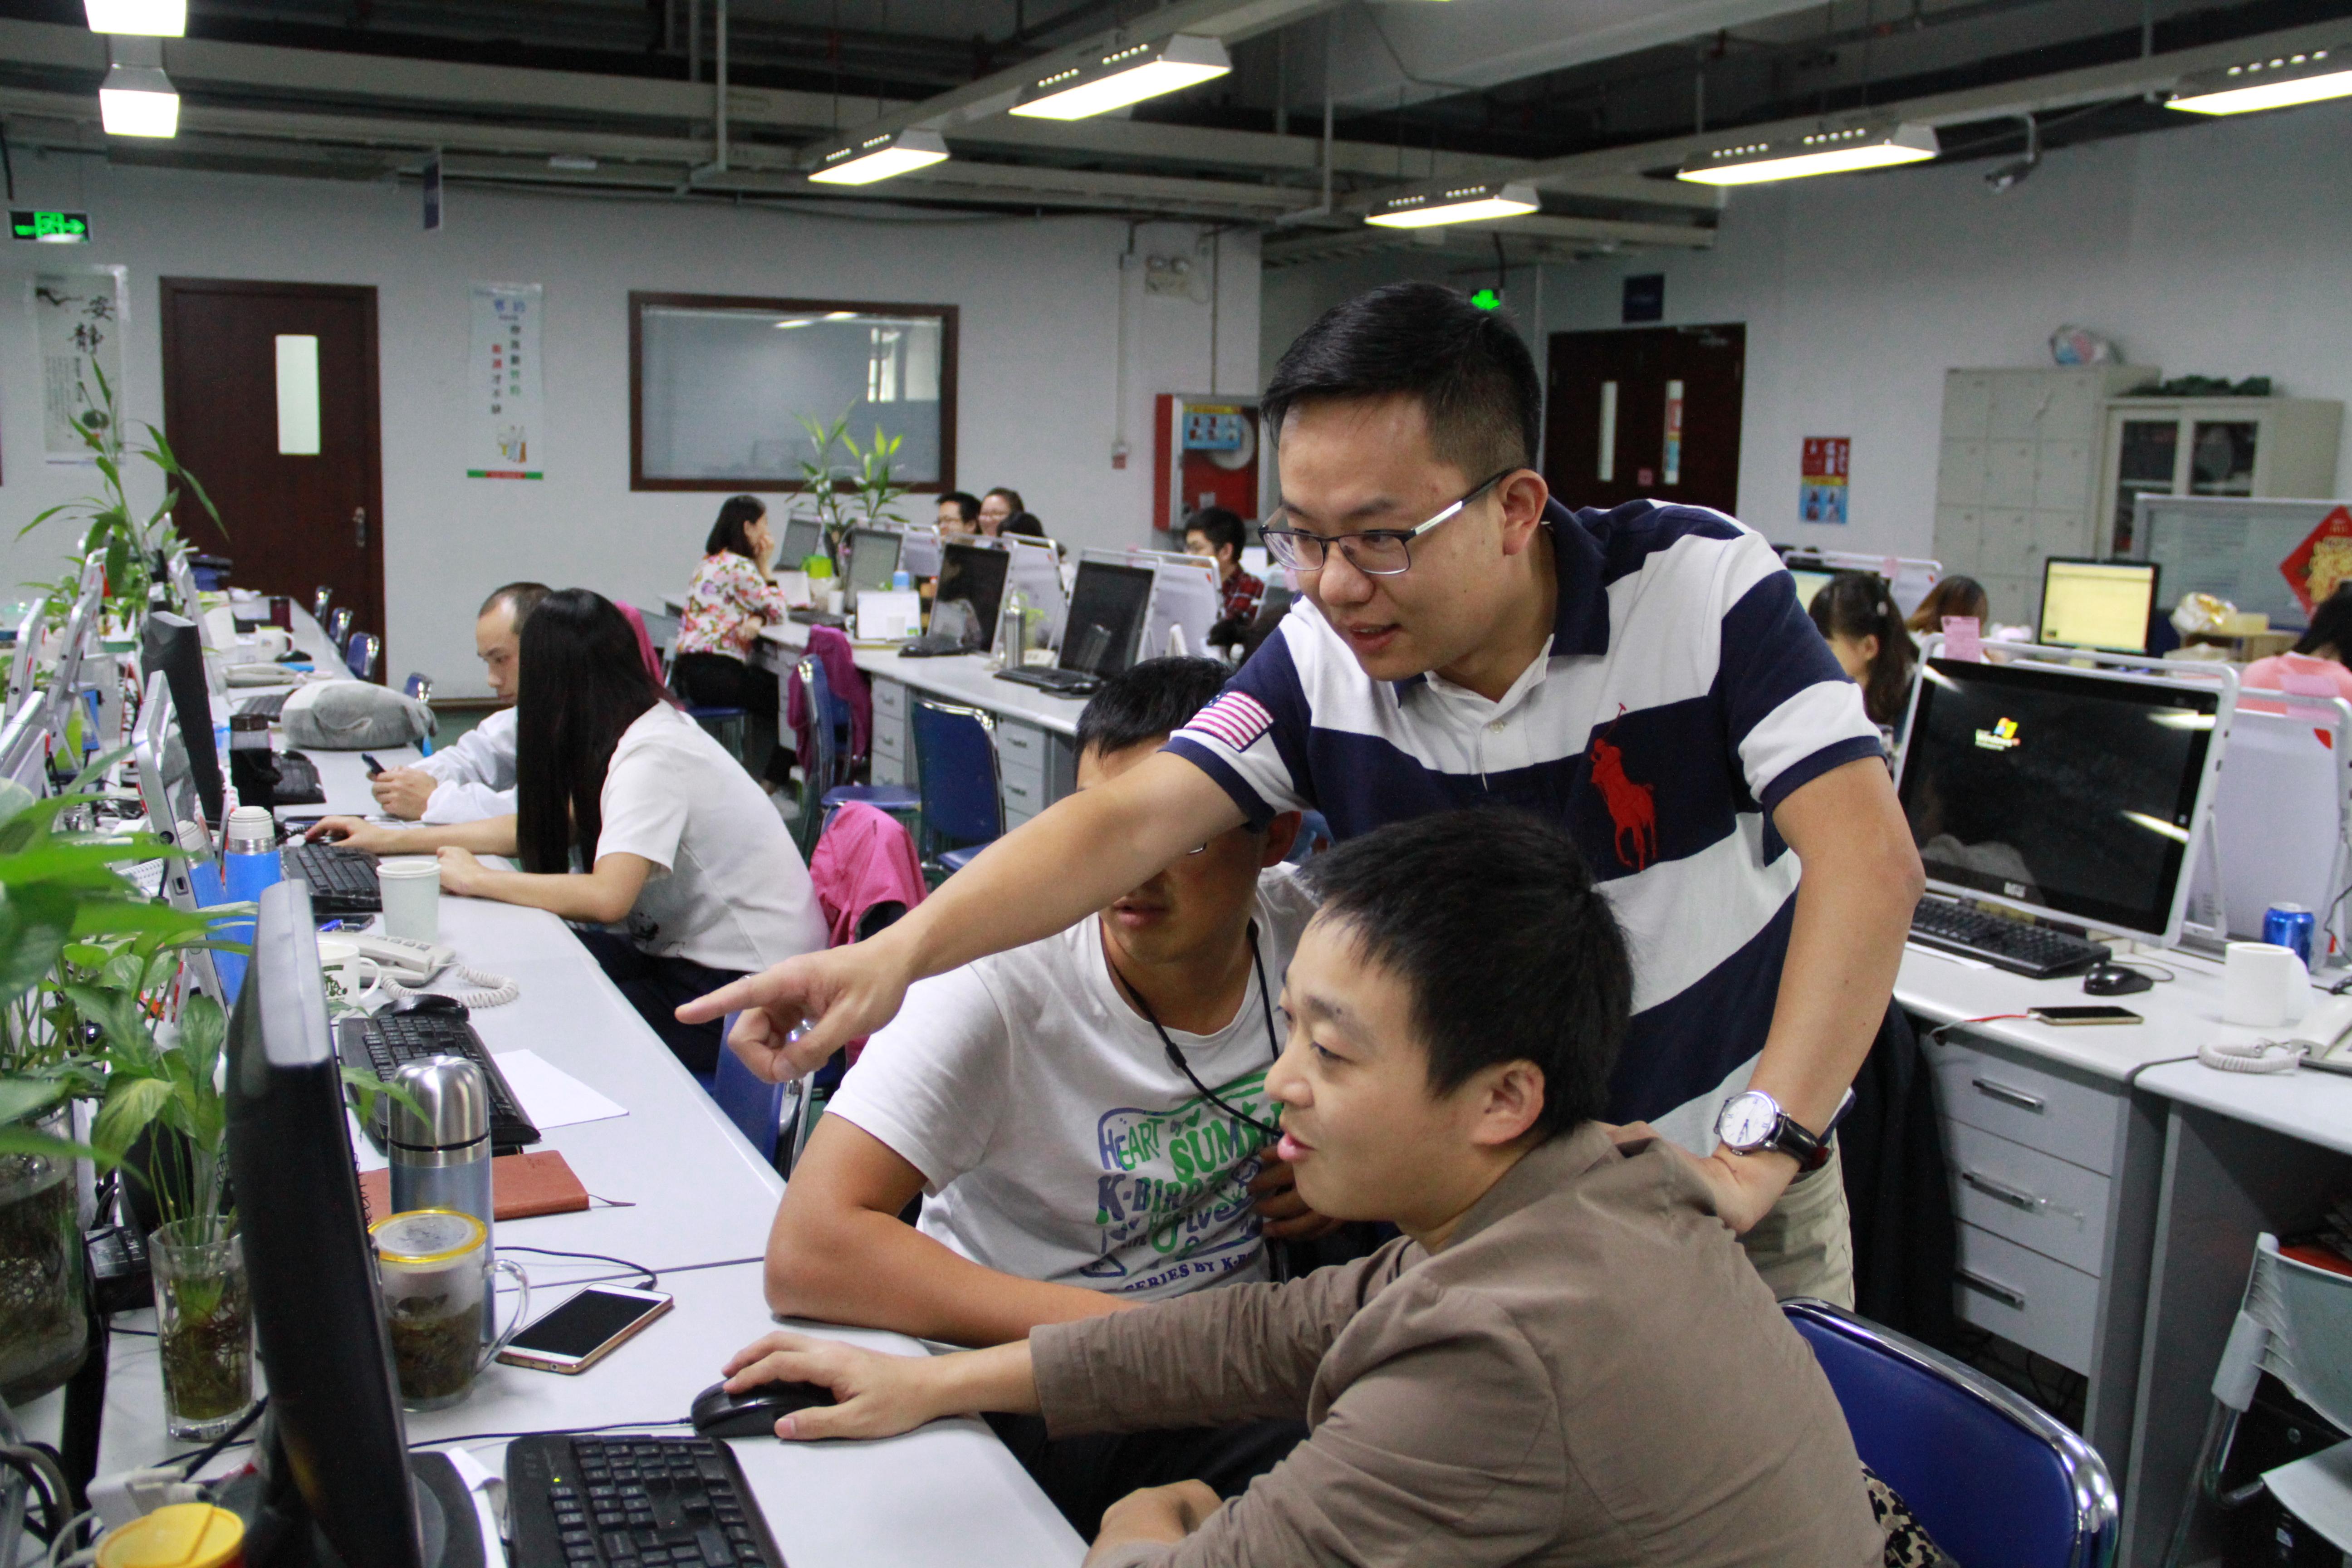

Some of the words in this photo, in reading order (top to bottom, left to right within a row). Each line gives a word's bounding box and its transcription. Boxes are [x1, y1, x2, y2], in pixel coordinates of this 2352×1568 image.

[67, 295, 115, 354] 安静
[1975, 732, 2013, 747] Windows
[1098, 1118, 1165, 1171] HEART
[1192, 1262, 1215, 1273] BY
